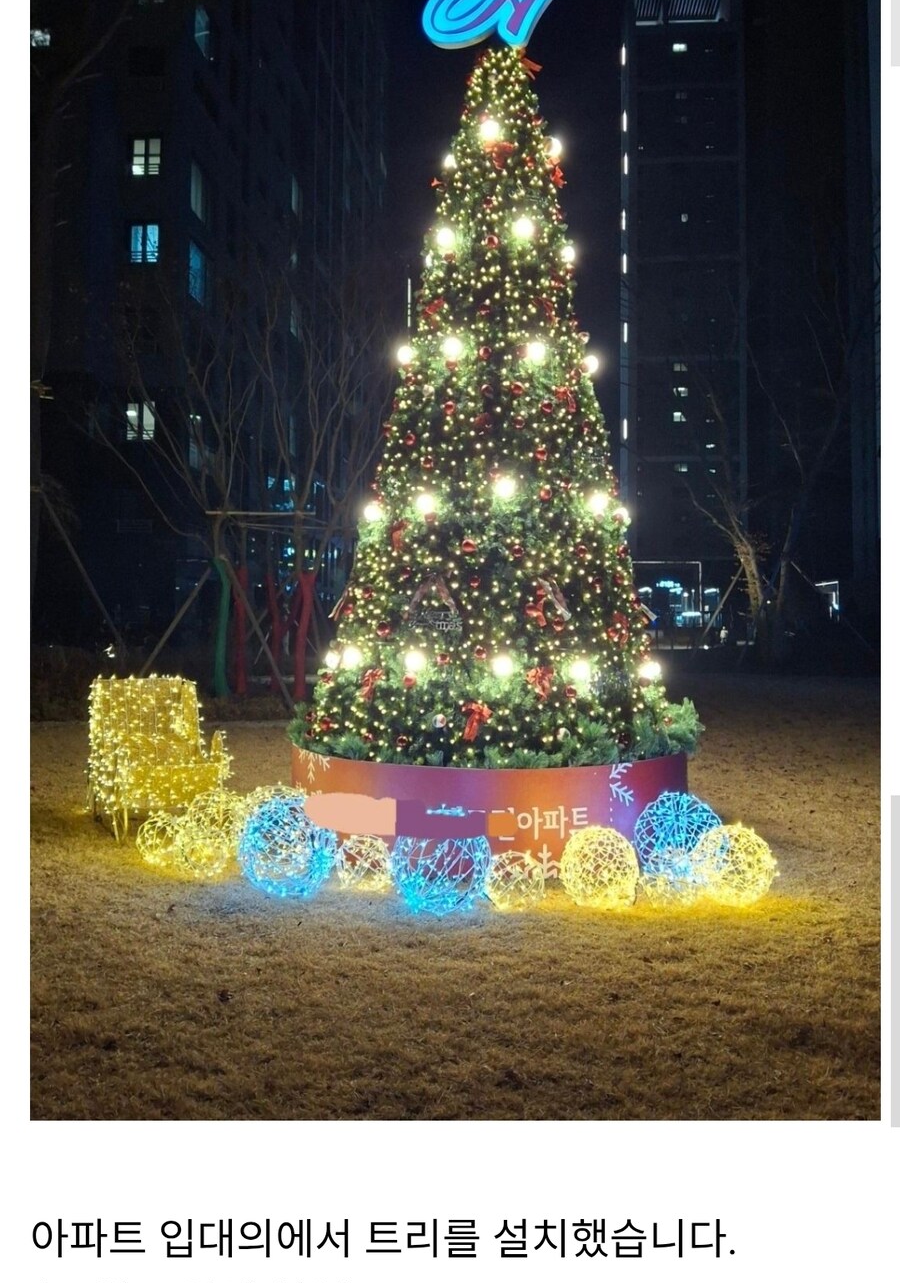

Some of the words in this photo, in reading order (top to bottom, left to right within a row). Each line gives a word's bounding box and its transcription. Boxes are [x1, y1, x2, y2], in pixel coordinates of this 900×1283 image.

[32, 1218, 146, 1259] 아파트
[160, 1218, 349, 1259] 입대의에서
[365, 1218, 481, 1259] 트리를
[493, 1218, 736, 1259] 설치했습니다.
